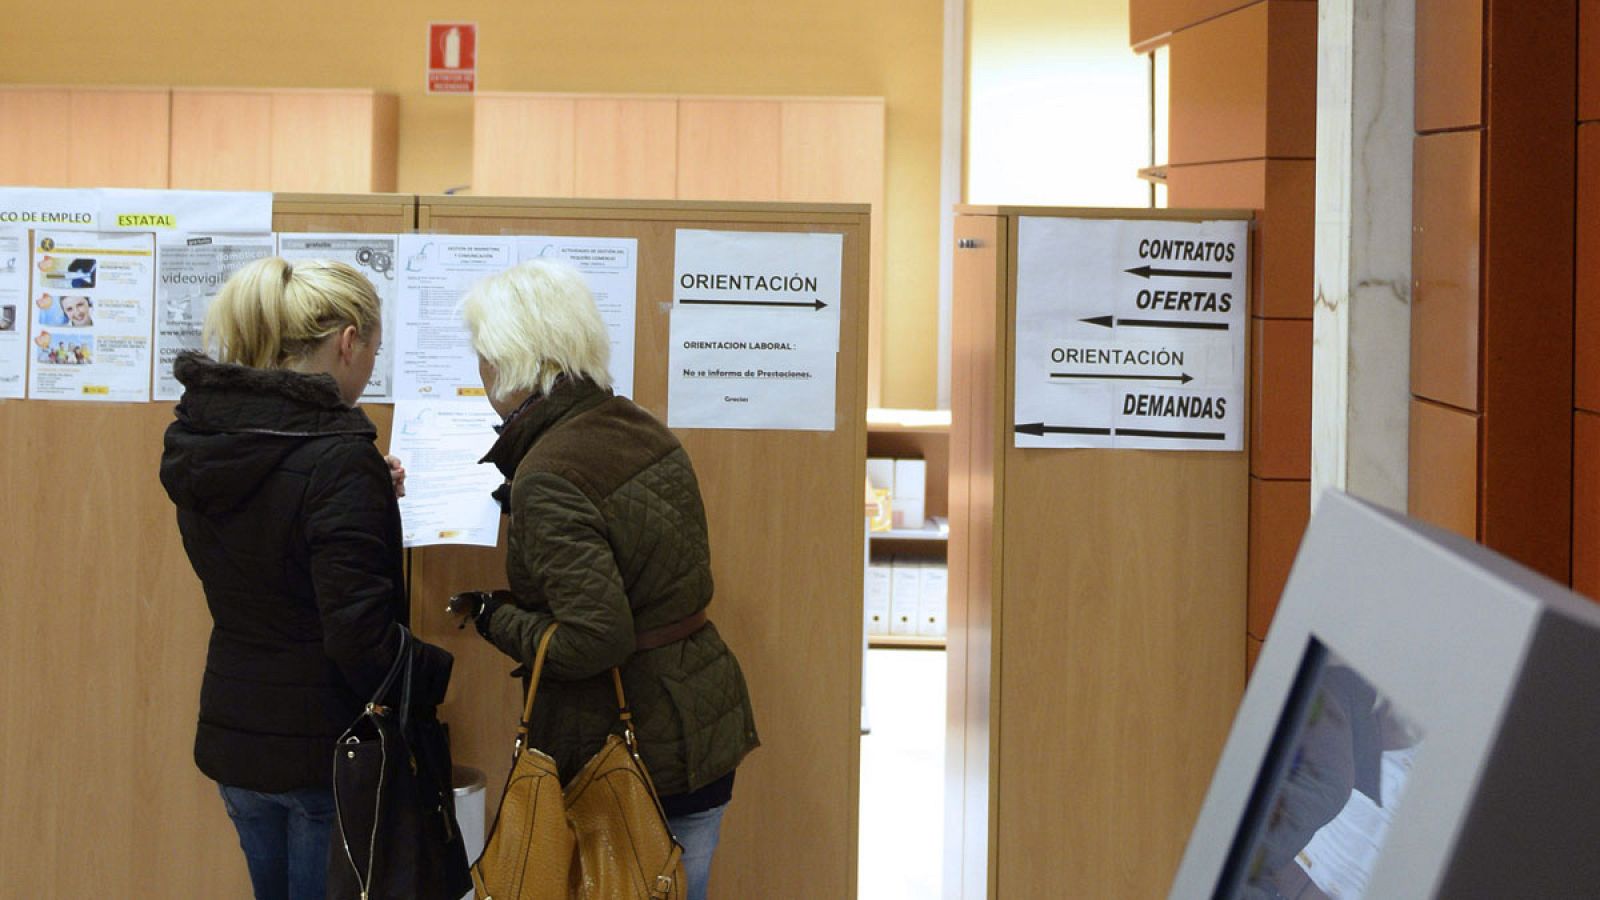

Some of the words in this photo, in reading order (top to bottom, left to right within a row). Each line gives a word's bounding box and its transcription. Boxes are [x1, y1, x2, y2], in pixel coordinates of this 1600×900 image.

[22, 211, 37, 222] DE
[41, 212, 91, 224] EMPLEO
[119, 214, 171, 226] ESTATAL
[1139, 239, 1235, 263] CONTRATOS
[680, 272, 817, 292] ORIENTACIÓN
[1136, 290, 1232, 312] OFERTAS
[683, 341, 746, 350] ORIENTACION
[1051, 347, 1184, 366] ORIENTACIÓN
[683, 368, 695, 377] No
[708, 368, 742, 377] informa
[744, 369, 755, 377] de
[757, 369, 812, 378] Prestaciones.
[1123, 394, 1226, 419] DEMANDAS
